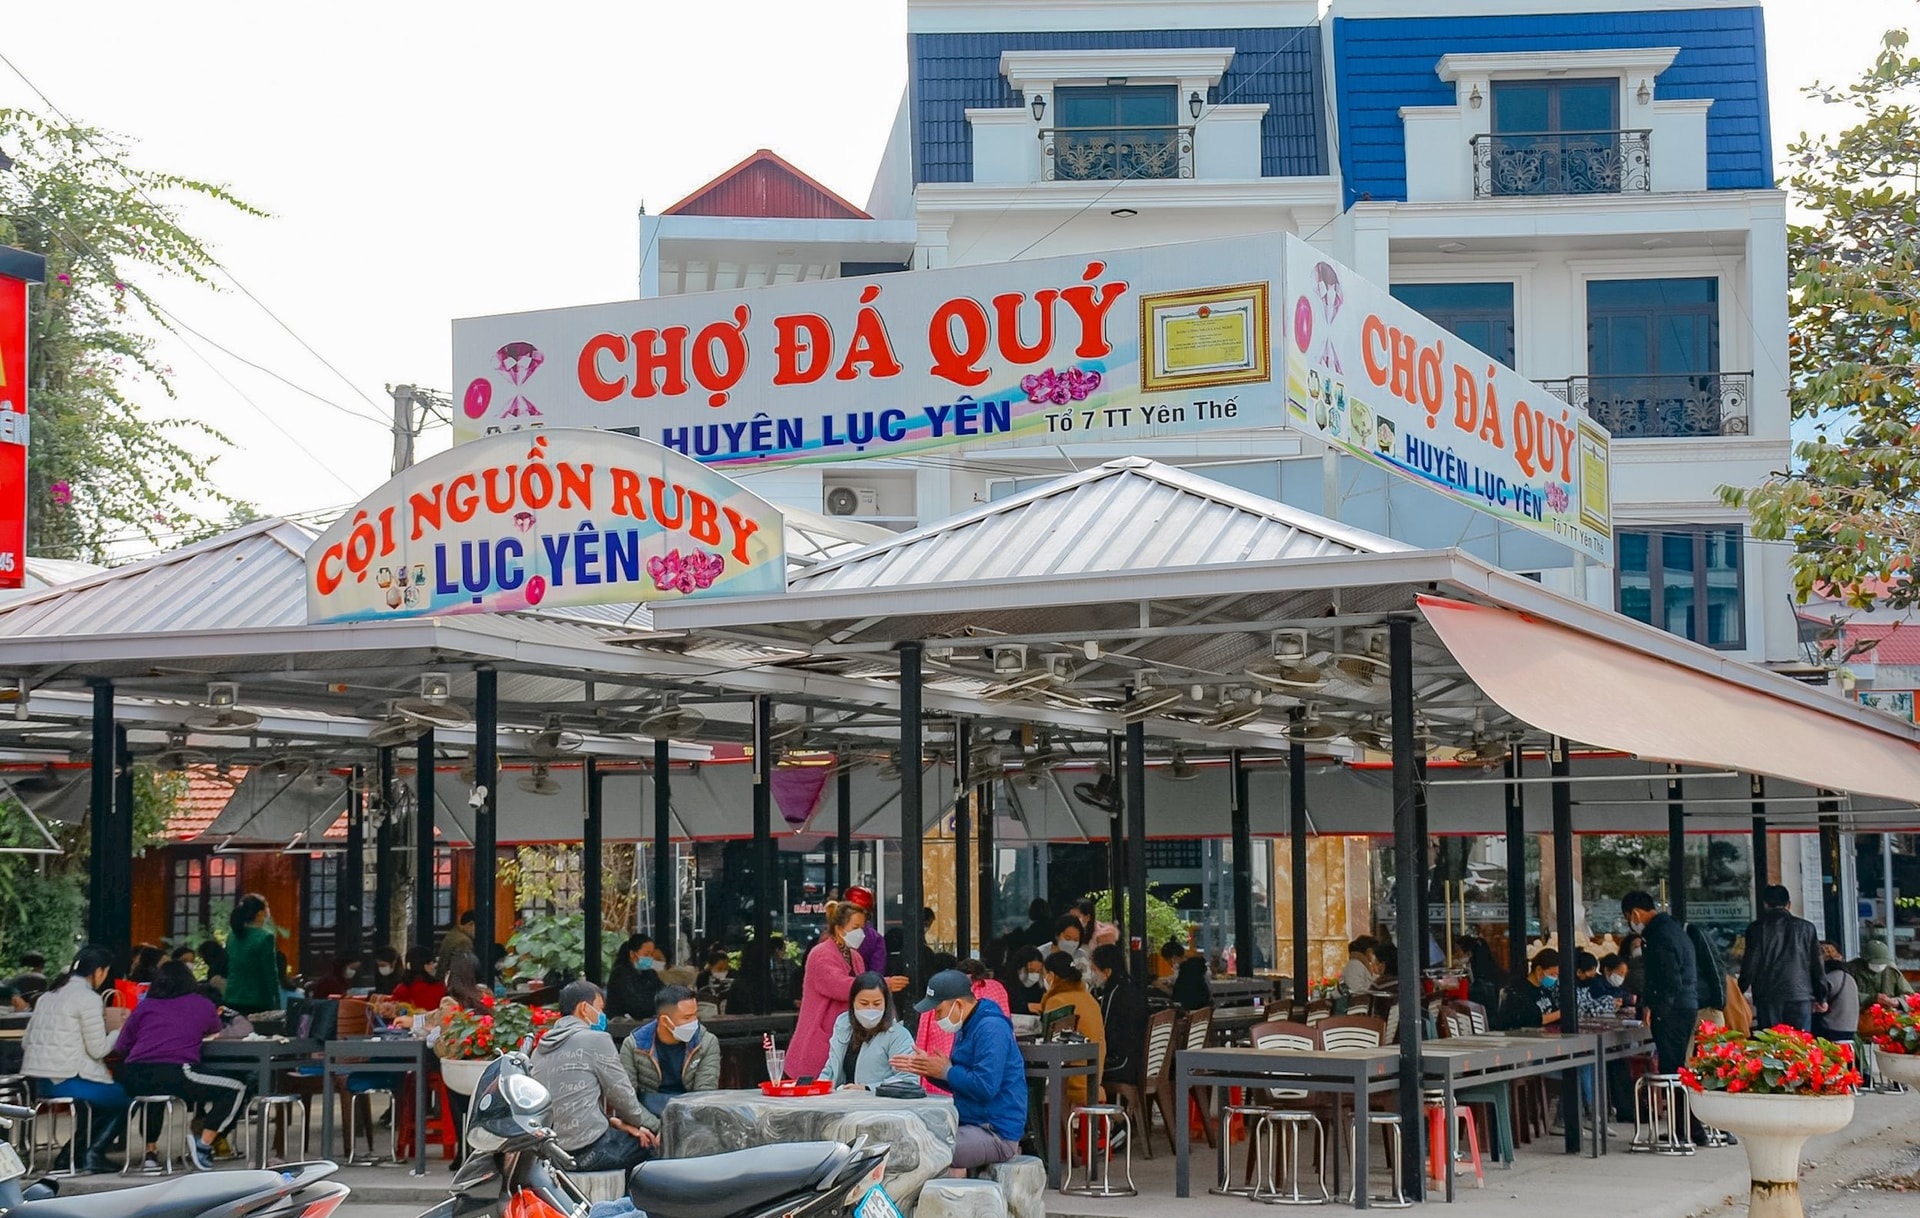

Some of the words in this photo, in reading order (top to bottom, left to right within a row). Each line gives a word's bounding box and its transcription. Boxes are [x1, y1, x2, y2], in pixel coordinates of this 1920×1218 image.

[578, 303, 749, 408] CHỢ
[773, 285, 902, 386] ĐÁ
[928, 261, 1130, 387] QUÝ
[663, 412, 803, 460] HUYỆN
[823, 407, 907, 452] LỤC
[923, 396, 1013, 437] YÊN
[1045, 408, 1073, 433] Tổ
[1081, 411, 1095, 430] 7
[1103, 408, 1132, 428] TT
[1140, 405, 1186, 425] Yên
[1193, 395, 1240, 420] Thế
[1362, 314, 1444, 430] CHỢ
[1453, 364, 1505, 449] ĐÁ
[1513, 400, 1575, 484] QUÝ
[316, 506, 396, 597] CỘI
[409, 435, 594, 542] NGUỒN
[610, 467, 759, 566] RUBY
[1406, 433, 1468, 490] HUYỆN
[1475, 467, 1507, 507] LỤC
[1512, 483, 1542, 522] YÊN
[434, 538, 524, 604] LỤC
[540, 519, 640, 587] YÊN
